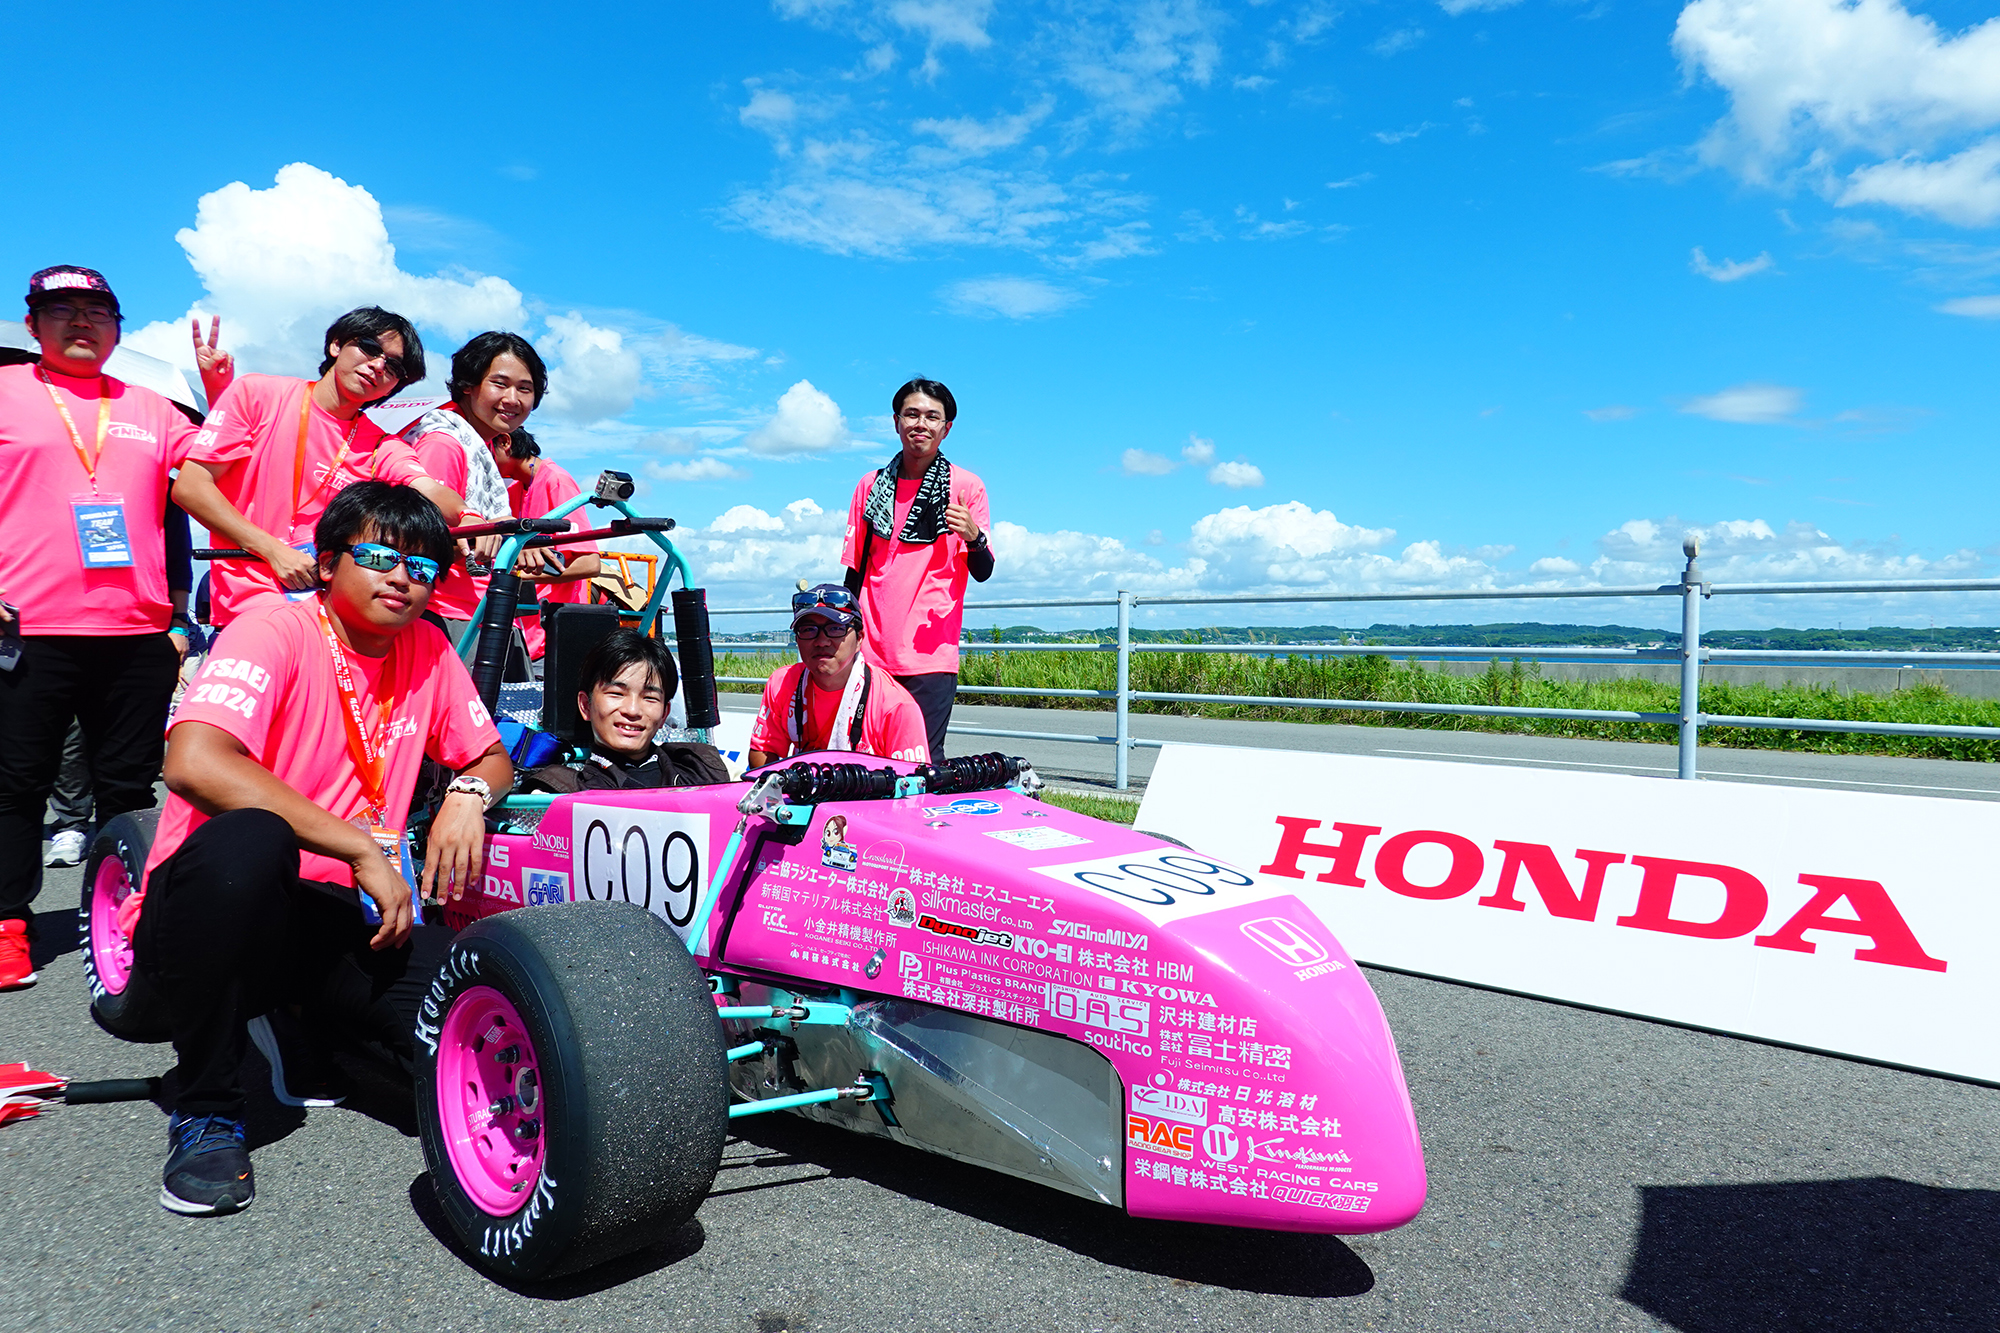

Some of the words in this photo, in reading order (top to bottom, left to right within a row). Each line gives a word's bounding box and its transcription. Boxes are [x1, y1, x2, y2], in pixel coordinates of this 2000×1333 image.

[43, 273, 92, 290] MARVEL
[202, 657, 271, 694] FSAEJ
[190, 682, 258, 719] 2024
[856, 703, 865, 719] EOS
[533, 829, 569, 851] SINOBU
[584, 819, 699, 927] C09
[1073, 855, 1255, 906] C09
[760, 881, 884, 922] 新報国マテリアル株式会社
[909, 867, 965, 895] 株式会社
[971, 882, 1056, 915] エスユーエス
[1259, 815, 1949, 974] HONDA
[763, 911, 789, 929] F.C.C.
[921, 891, 1002, 923] silkmaster
[1017, 919, 1035, 931] LTD.
[803, 916, 898, 949] 小金井精機製作所
[804, 932, 834, 944] KOGANEI
[834, 938, 852, 948] SEIKI
[918, 914, 1013, 948] Dynojet
[922, 940, 977, 963] ISHIKAWA
[980, 952, 1000, 968] INK
[1002, 956, 1093, 988] CORPORATION
[1014, 934, 1073, 965] KYO-EI
[1077, 948, 1150, 978] 株式会社
[1156, 961, 1194, 983] HBM
[935, 963, 958, 976] Plus
[961, 968, 1002, 986] Plastics
[1004, 978, 1047, 995] BRAND
[939, 976, 964, 989] 有限会社
[1293, 959, 1347, 981] HONDA
[902, 980, 1041, 1027] 株式会社深井製作所
[1053, 984, 1081, 994] OHSHIMA
[1090, 992, 1108, 1000] AUTO
[1117, 998, 1148, 1008] SERVICE
[1120, 979, 1219, 1008] KYOWA
[1055, 991, 1144, 1035] OAS
[1158, 1005, 1258, 1037] 沢井建材店
[1084, 1030, 1153, 1058] southco
[1161, 1055, 1182, 1068] Fuji
[1185, 1059, 1240, 1078] Seimitsu
[1177, 1077, 1231, 1099] 株式会社
[1128, 1115, 1193, 1152] RAC
[1128, 1139, 1152, 1150] RACING
[1152, 1145, 1172, 1155] GEAR
[1172, 1150, 1192, 1158] SHOP
[1134, 1157, 1270, 1200] 栄鋼管株式会社
[1200, 1159, 1249, 1175] WEST
[1256, 1168, 1321, 1187] RACING
[1329, 1177, 1379, 1192] CARS
